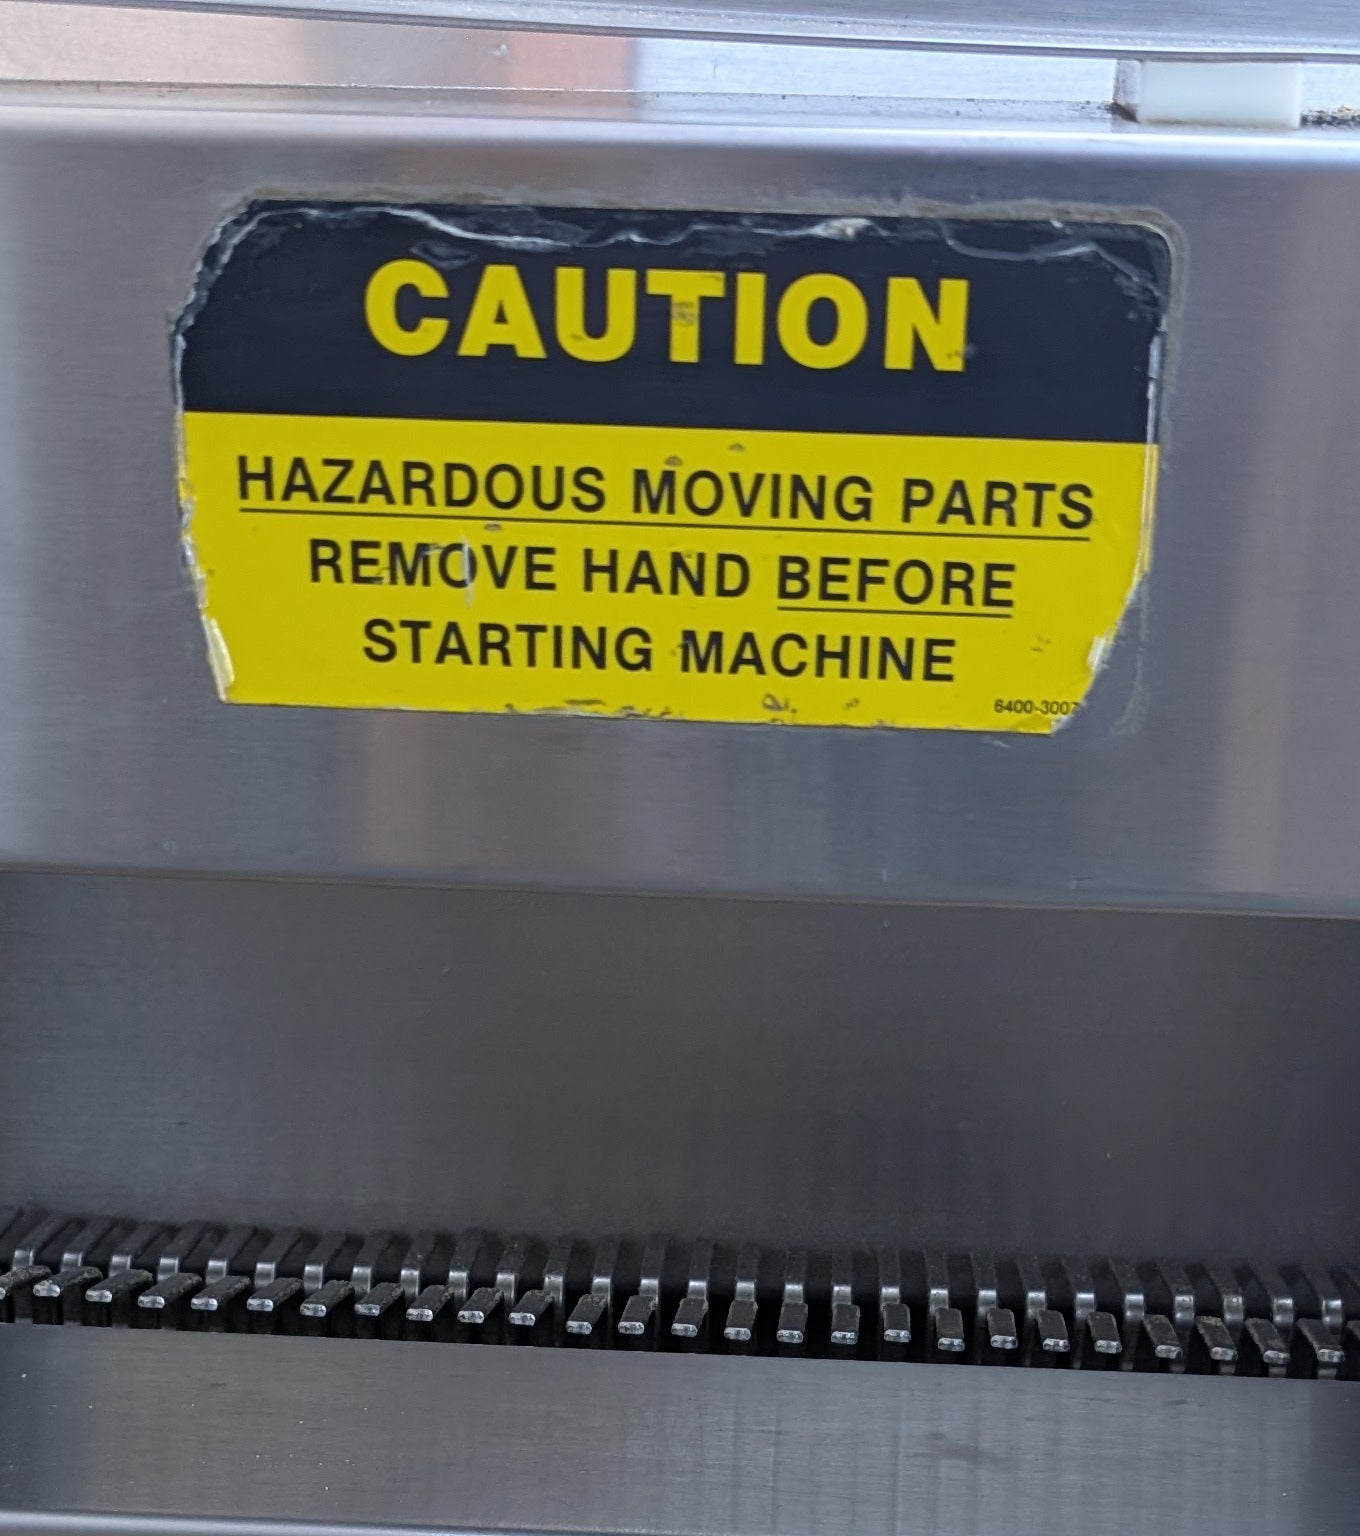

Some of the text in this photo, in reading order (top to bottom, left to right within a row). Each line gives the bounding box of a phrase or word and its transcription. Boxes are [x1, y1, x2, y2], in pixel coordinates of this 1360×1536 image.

[365, 259, 969, 372] CAUTION
[238, 455, 1093, 530] HAZARDOUS MOVING PARTS
[310, 538, 1016, 608] REMOVE HAND BEFORE
[363, 618, 956, 682] STARTING MACHINE
